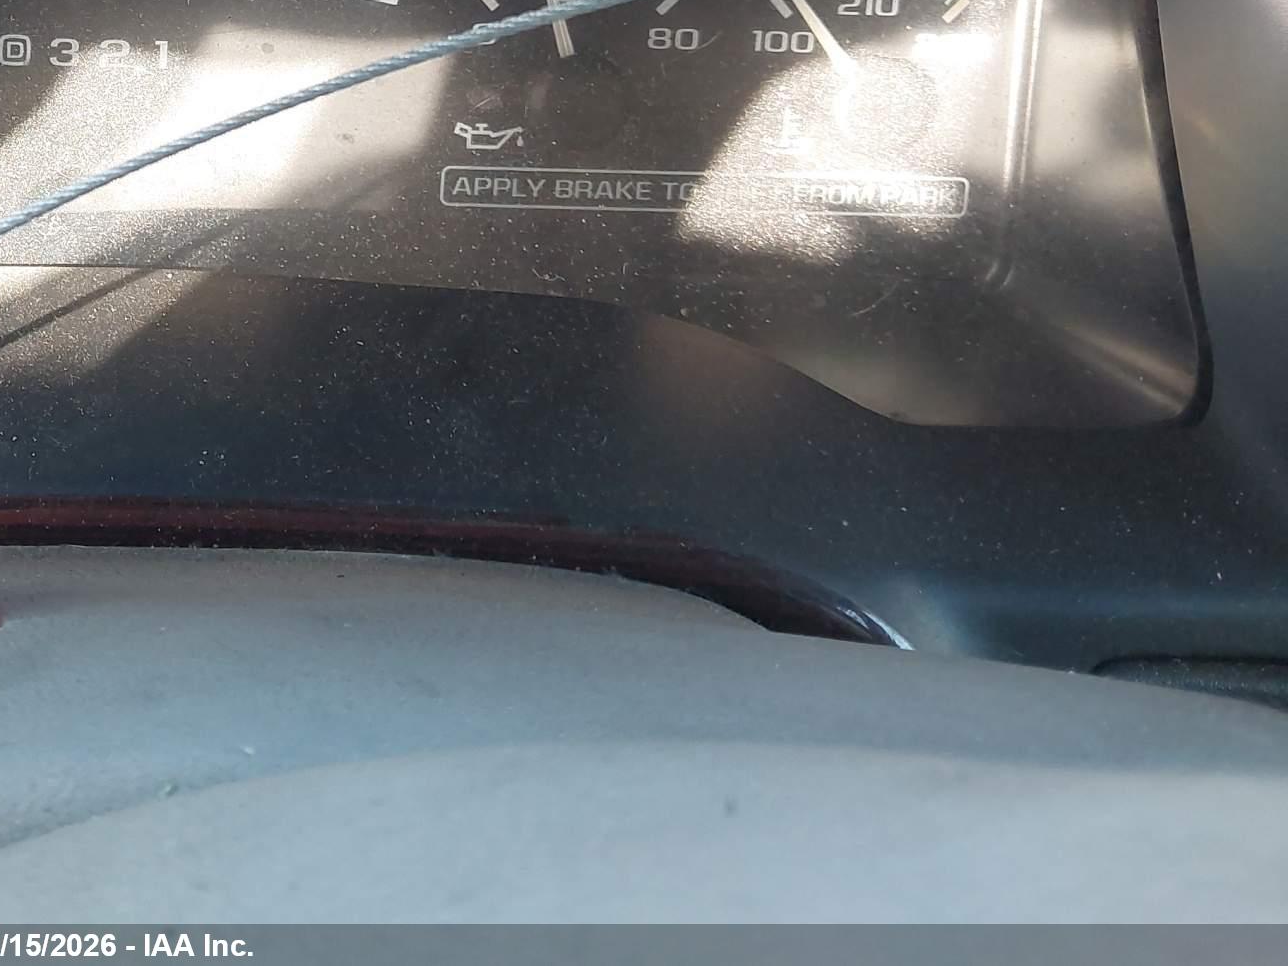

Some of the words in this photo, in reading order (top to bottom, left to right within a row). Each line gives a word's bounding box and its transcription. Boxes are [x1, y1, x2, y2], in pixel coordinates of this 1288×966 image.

[648, 28, 699, 51] 80
[753, 30, 813, 54] 100
[452, 177, 546, 198] APPLY
[555, 180, 652, 201] BRAKE
